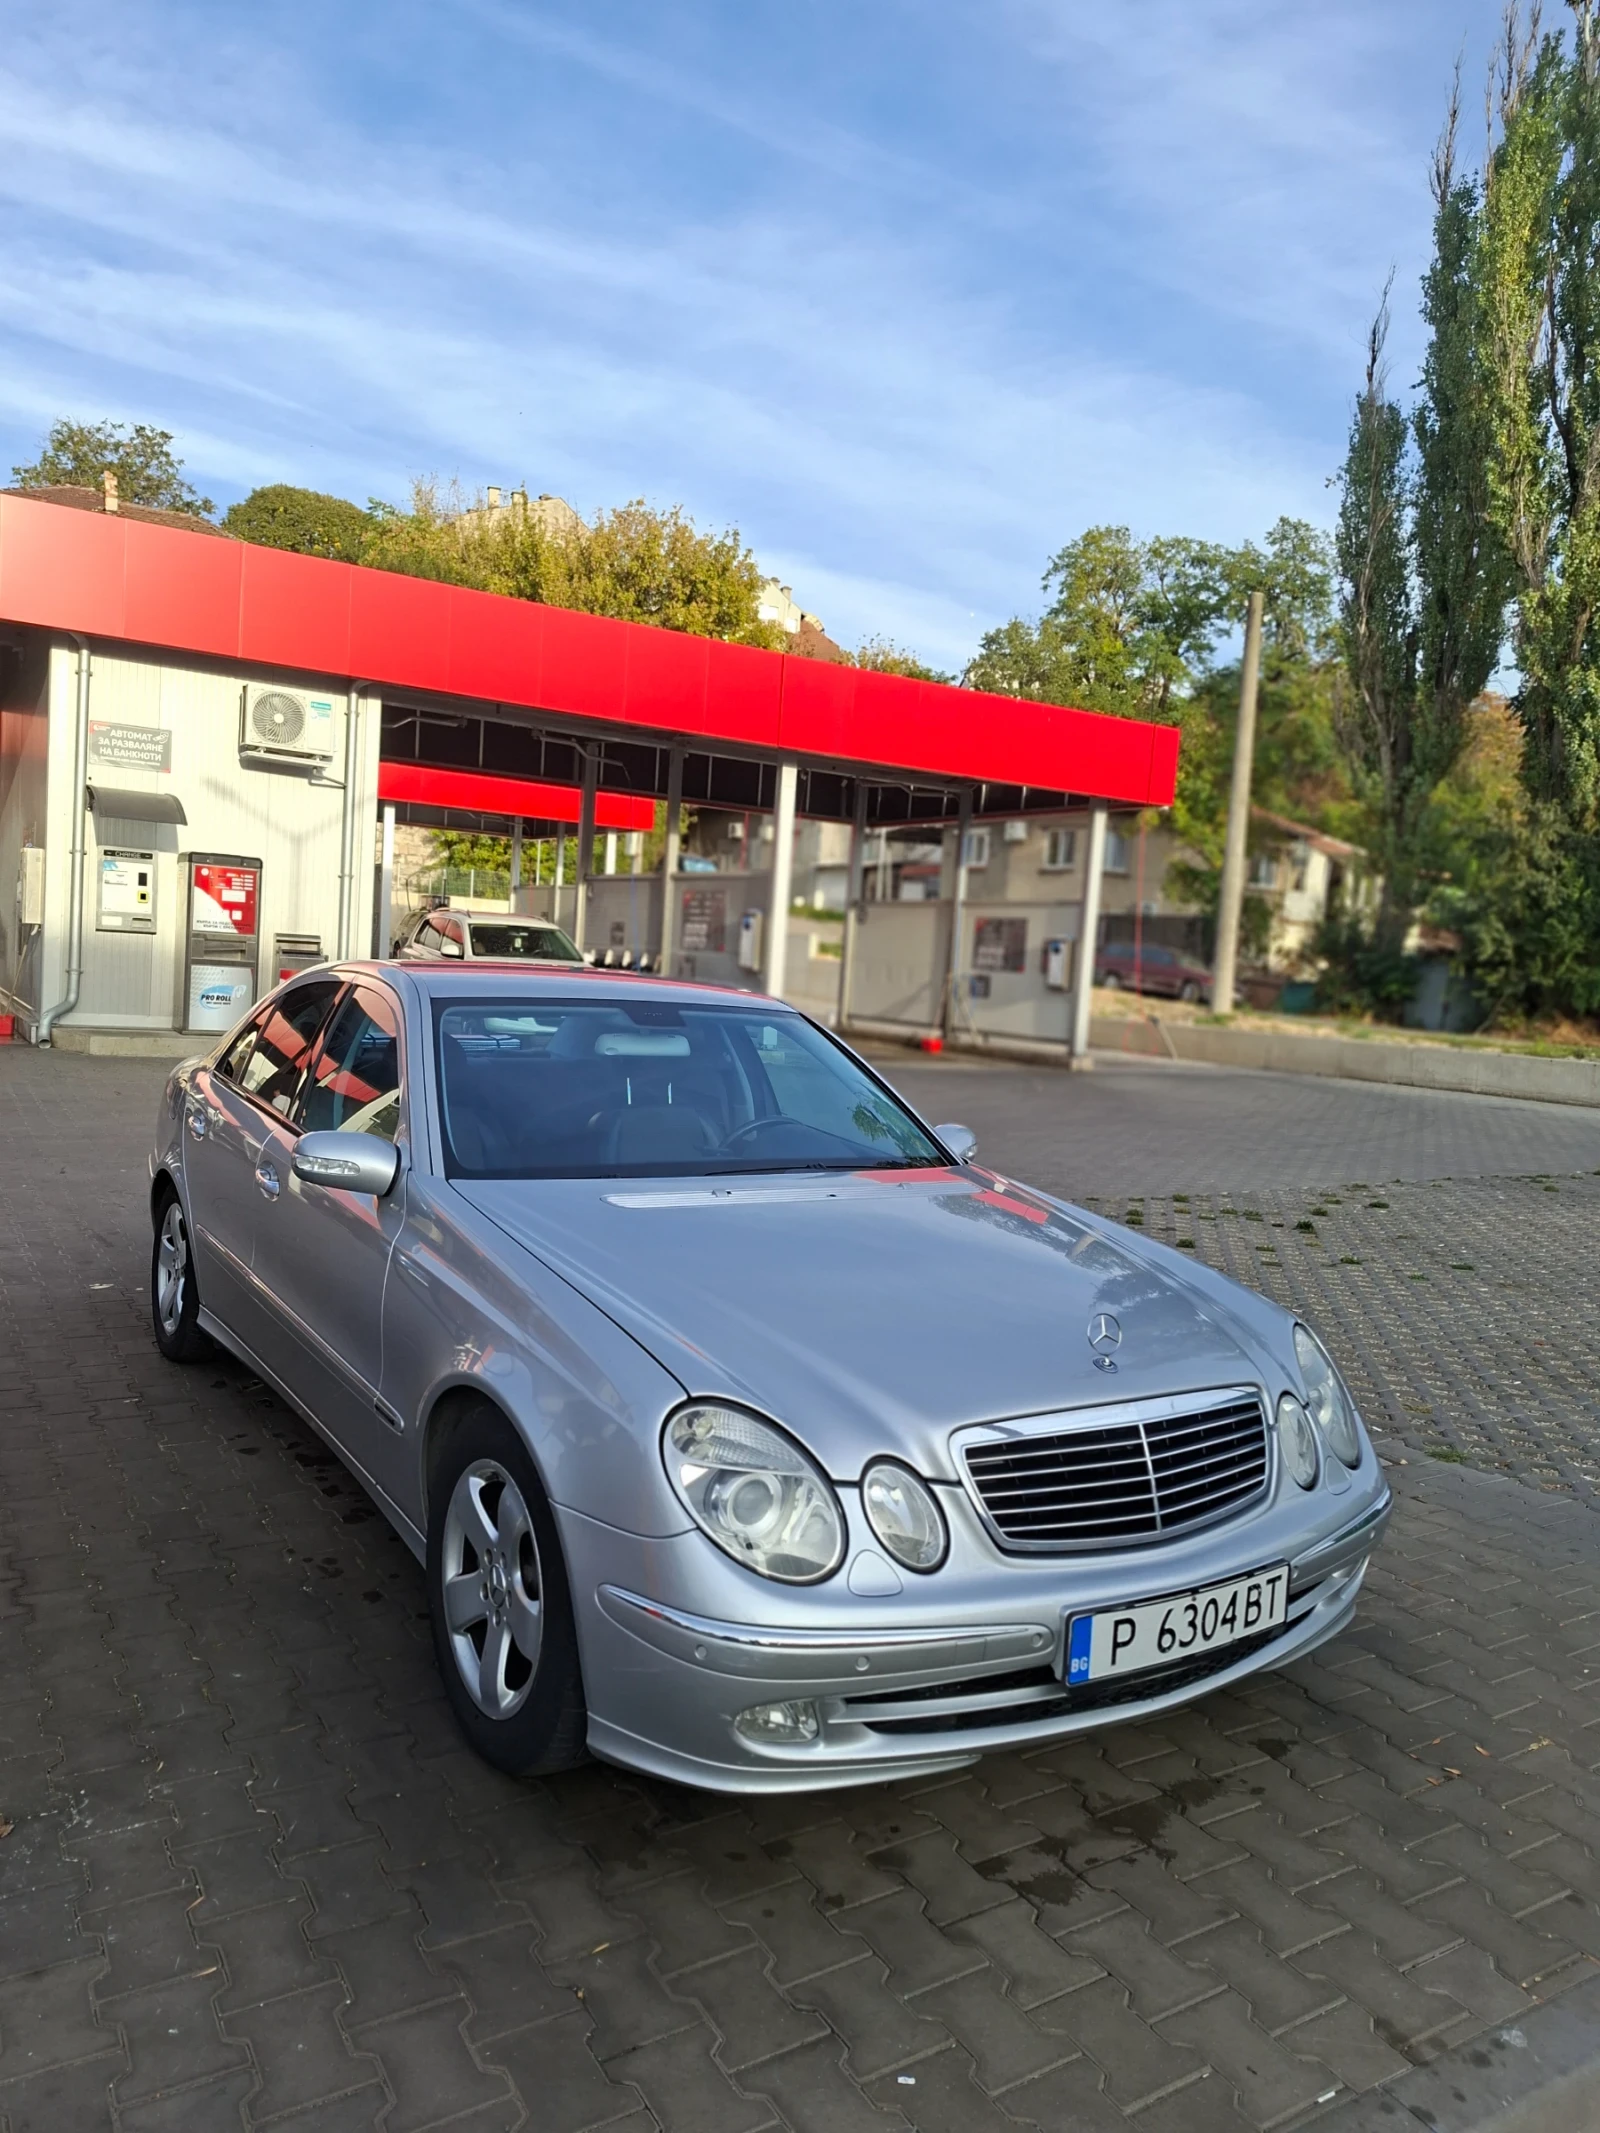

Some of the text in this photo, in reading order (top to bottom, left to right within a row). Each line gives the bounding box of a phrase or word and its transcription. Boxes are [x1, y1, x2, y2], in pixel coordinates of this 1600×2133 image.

[110, 729, 153, 741] АВТОМАТ
[98, 737, 163, 752] ЗА РАЗВАЛЯНЕ
[100, 747, 112, 755] НА
[114, 748, 162, 761] БАНКНОТИ
[115, 850, 141, 859] CHANGE
[1111, 1617, 1136, 1666] P
[1071, 1656, 1089, 1673] BG
